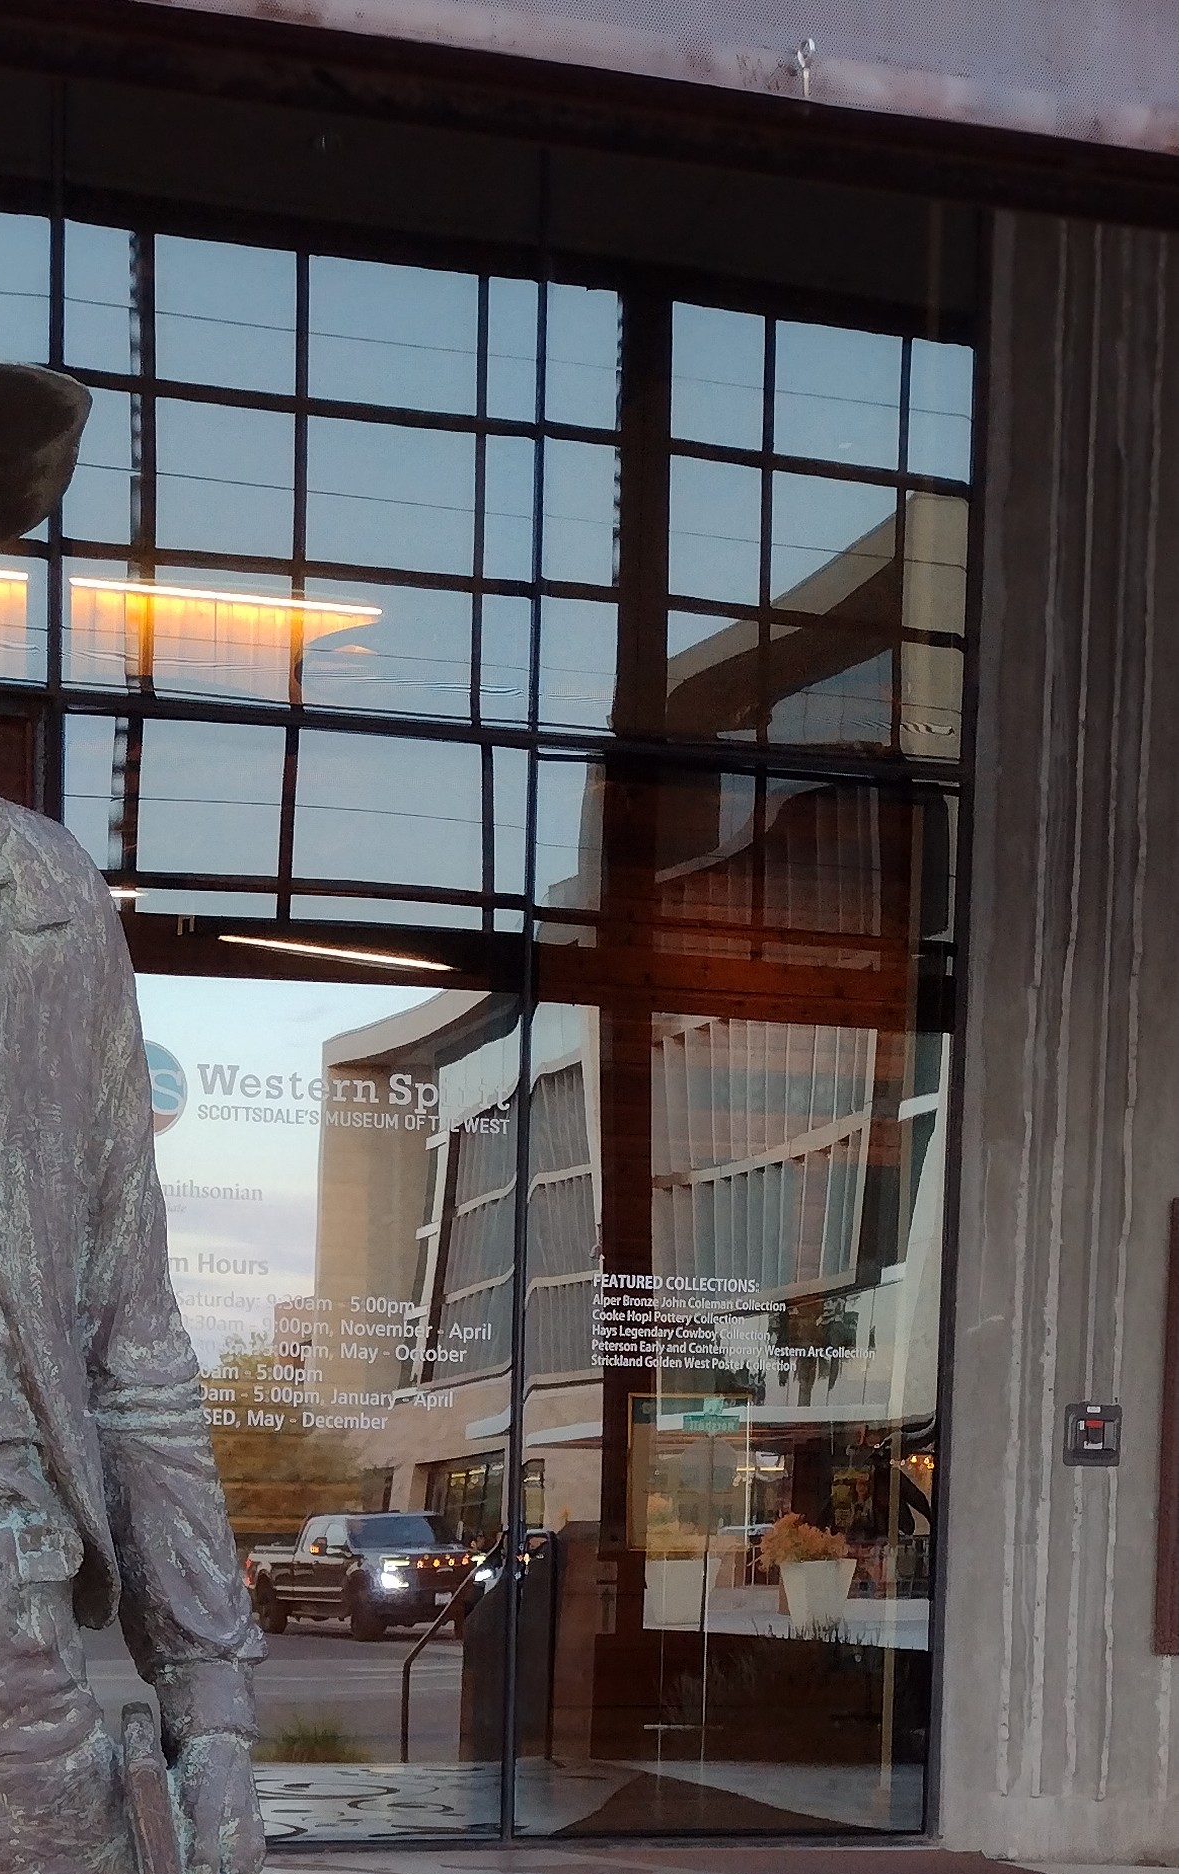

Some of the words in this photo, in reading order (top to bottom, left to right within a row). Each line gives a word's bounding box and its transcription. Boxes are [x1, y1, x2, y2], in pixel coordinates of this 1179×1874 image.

[197, 1063, 380, 1105] Western
[197, 1104, 320, 1125] SCOTTSDALE'S
[325, 1111, 399, 1130] MUSEUM
[404, 1114, 426, 1131] OF
[463, 1117, 510, 1135] WEST
[162, 1179, 263, 1201] mithsonian
[198, 1253, 269, 1276] Hours
[593, 1273, 663, 1290] FEATURED
[666, 1276, 760, 1293] COLLECTIONS:
[176, 1291, 261, 1313] Saturday:
[267, 1294, 333, 1311] 9:30am
[592, 1294, 621, 1308] Alper
[623, 1296, 658, 1307] Bronze
[661, 1296, 686, 1308] John
[688, 1297, 733, 1309] Coleman
[735, 1299, 787, 1312] Collection
[592, 1309, 625, 1321] Cooke
[654, 1311, 692, 1326] Pottery
[694, 1313, 745, 1325] Collection
[262, 1316, 334, 1337] 9:00pm,
[341, 1320, 433, 1338] November
[449, 1322, 492, 1343] April
[592, 1325, 618, 1338] Hays
[619, 1325, 674, 1339] Legendary
[676, 1327, 718, 1341] Cowboy
[719, 1328, 771, 1341] Collection
[341, 1343, 379, 1364] May
[395, 1344, 468, 1363] October
[591, 1339, 638, 1351] Peterson
[639, 1340, 666, 1354] Early
[667, 1342, 687, 1353] and
[688, 1342, 762, 1357] Contemporary
[765, 1345, 806, 1356] Western
[807, 1346, 824, 1357] Art
[825, 1347, 876, 1359] Collection
[591, 1354, 643, 1367] Strickland
[645, 1356, 682, 1368] Golden
[684, 1356, 710, 1369] West
[712, 1357, 743, 1370] Poster
[745, 1359, 797, 1372] Collection
[256, 1363, 323, 1385] 5:00pm
[253, 1386, 326, 1408] 5:00pm,
[331, 1388, 397, 1410] January
[414, 1392, 454, 1411] April
[248, 1410, 285, 1431] May
[303, 1411, 389, 1430] December
